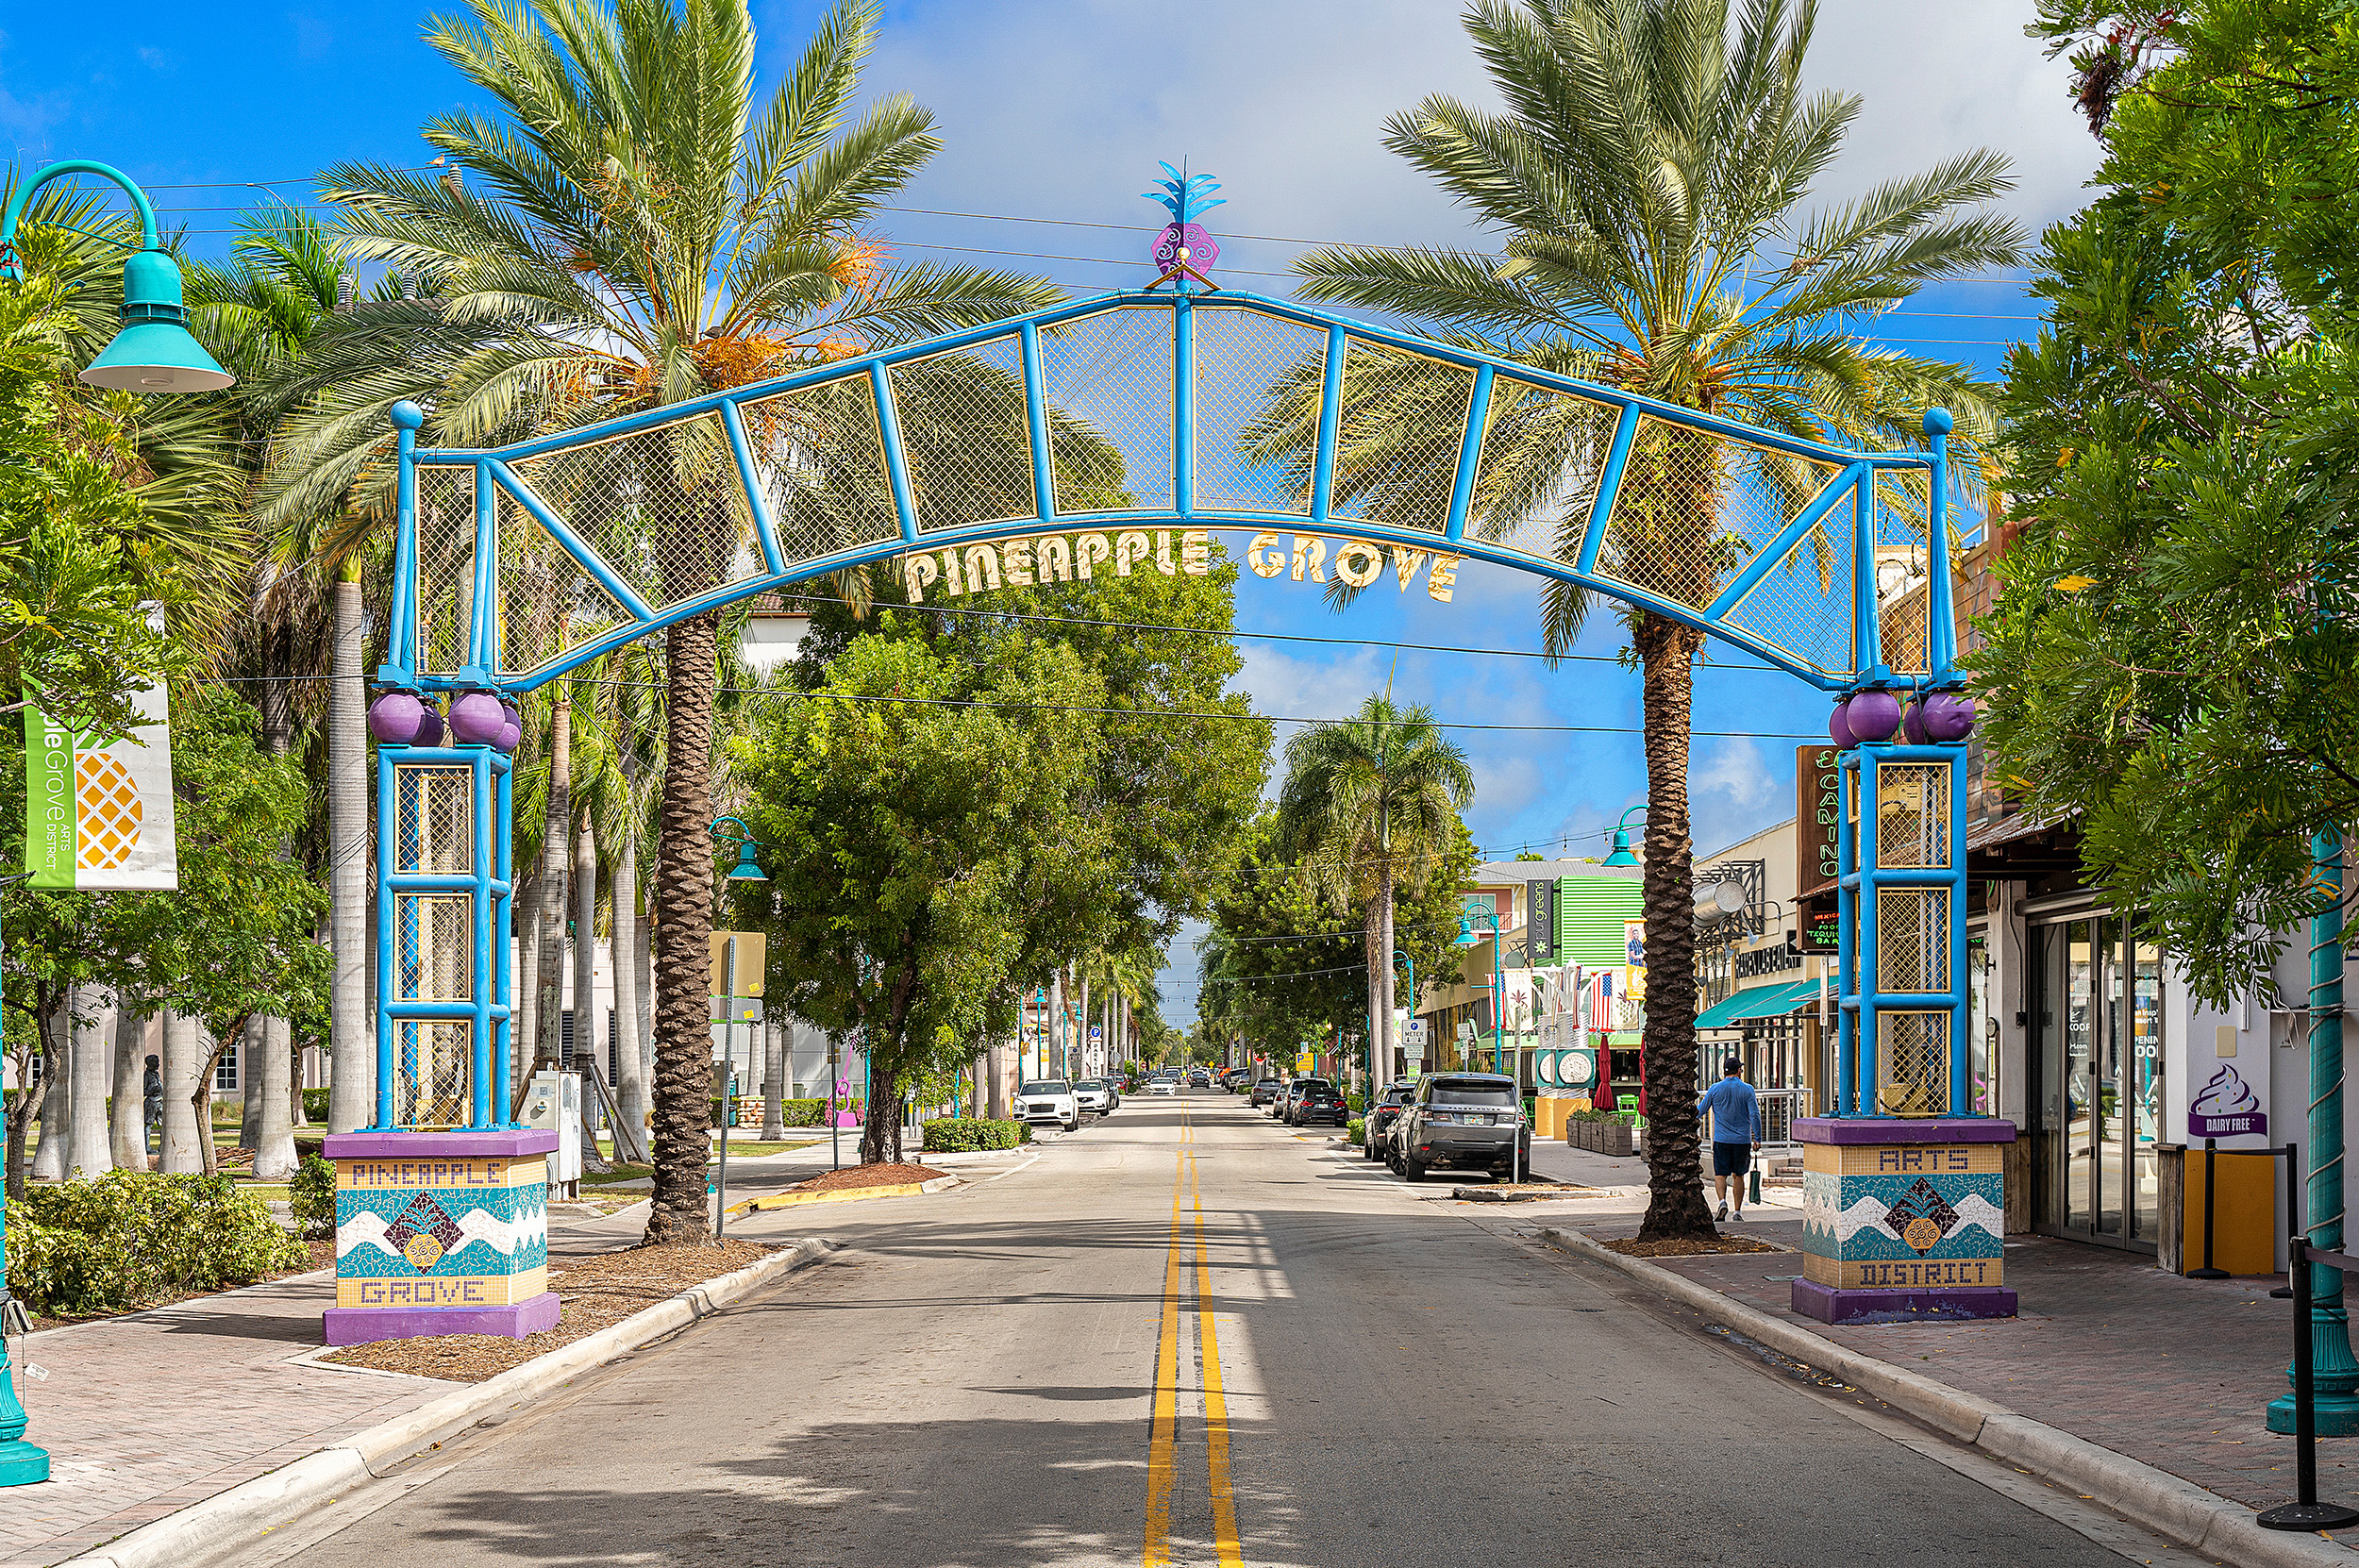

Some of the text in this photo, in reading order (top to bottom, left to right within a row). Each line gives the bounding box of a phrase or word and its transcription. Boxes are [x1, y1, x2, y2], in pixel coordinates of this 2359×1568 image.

[904, 528, 1460, 604] PINEAPPLE GROVE
[46, 824, 57, 870] DISTRICT
[60, 823, 71, 851] ARTS
[1535, 882, 1548, 940] purgreens
[2206, 1117, 2250, 1132] DAIRY FREE
[1880, 1149, 1968, 1172] ARTS
[353, 1162, 500, 1186] PINEAPPLE
[1860, 1262, 1987, 1286] DISTRICT
[361, 1280, 484, 1304] GROVE
